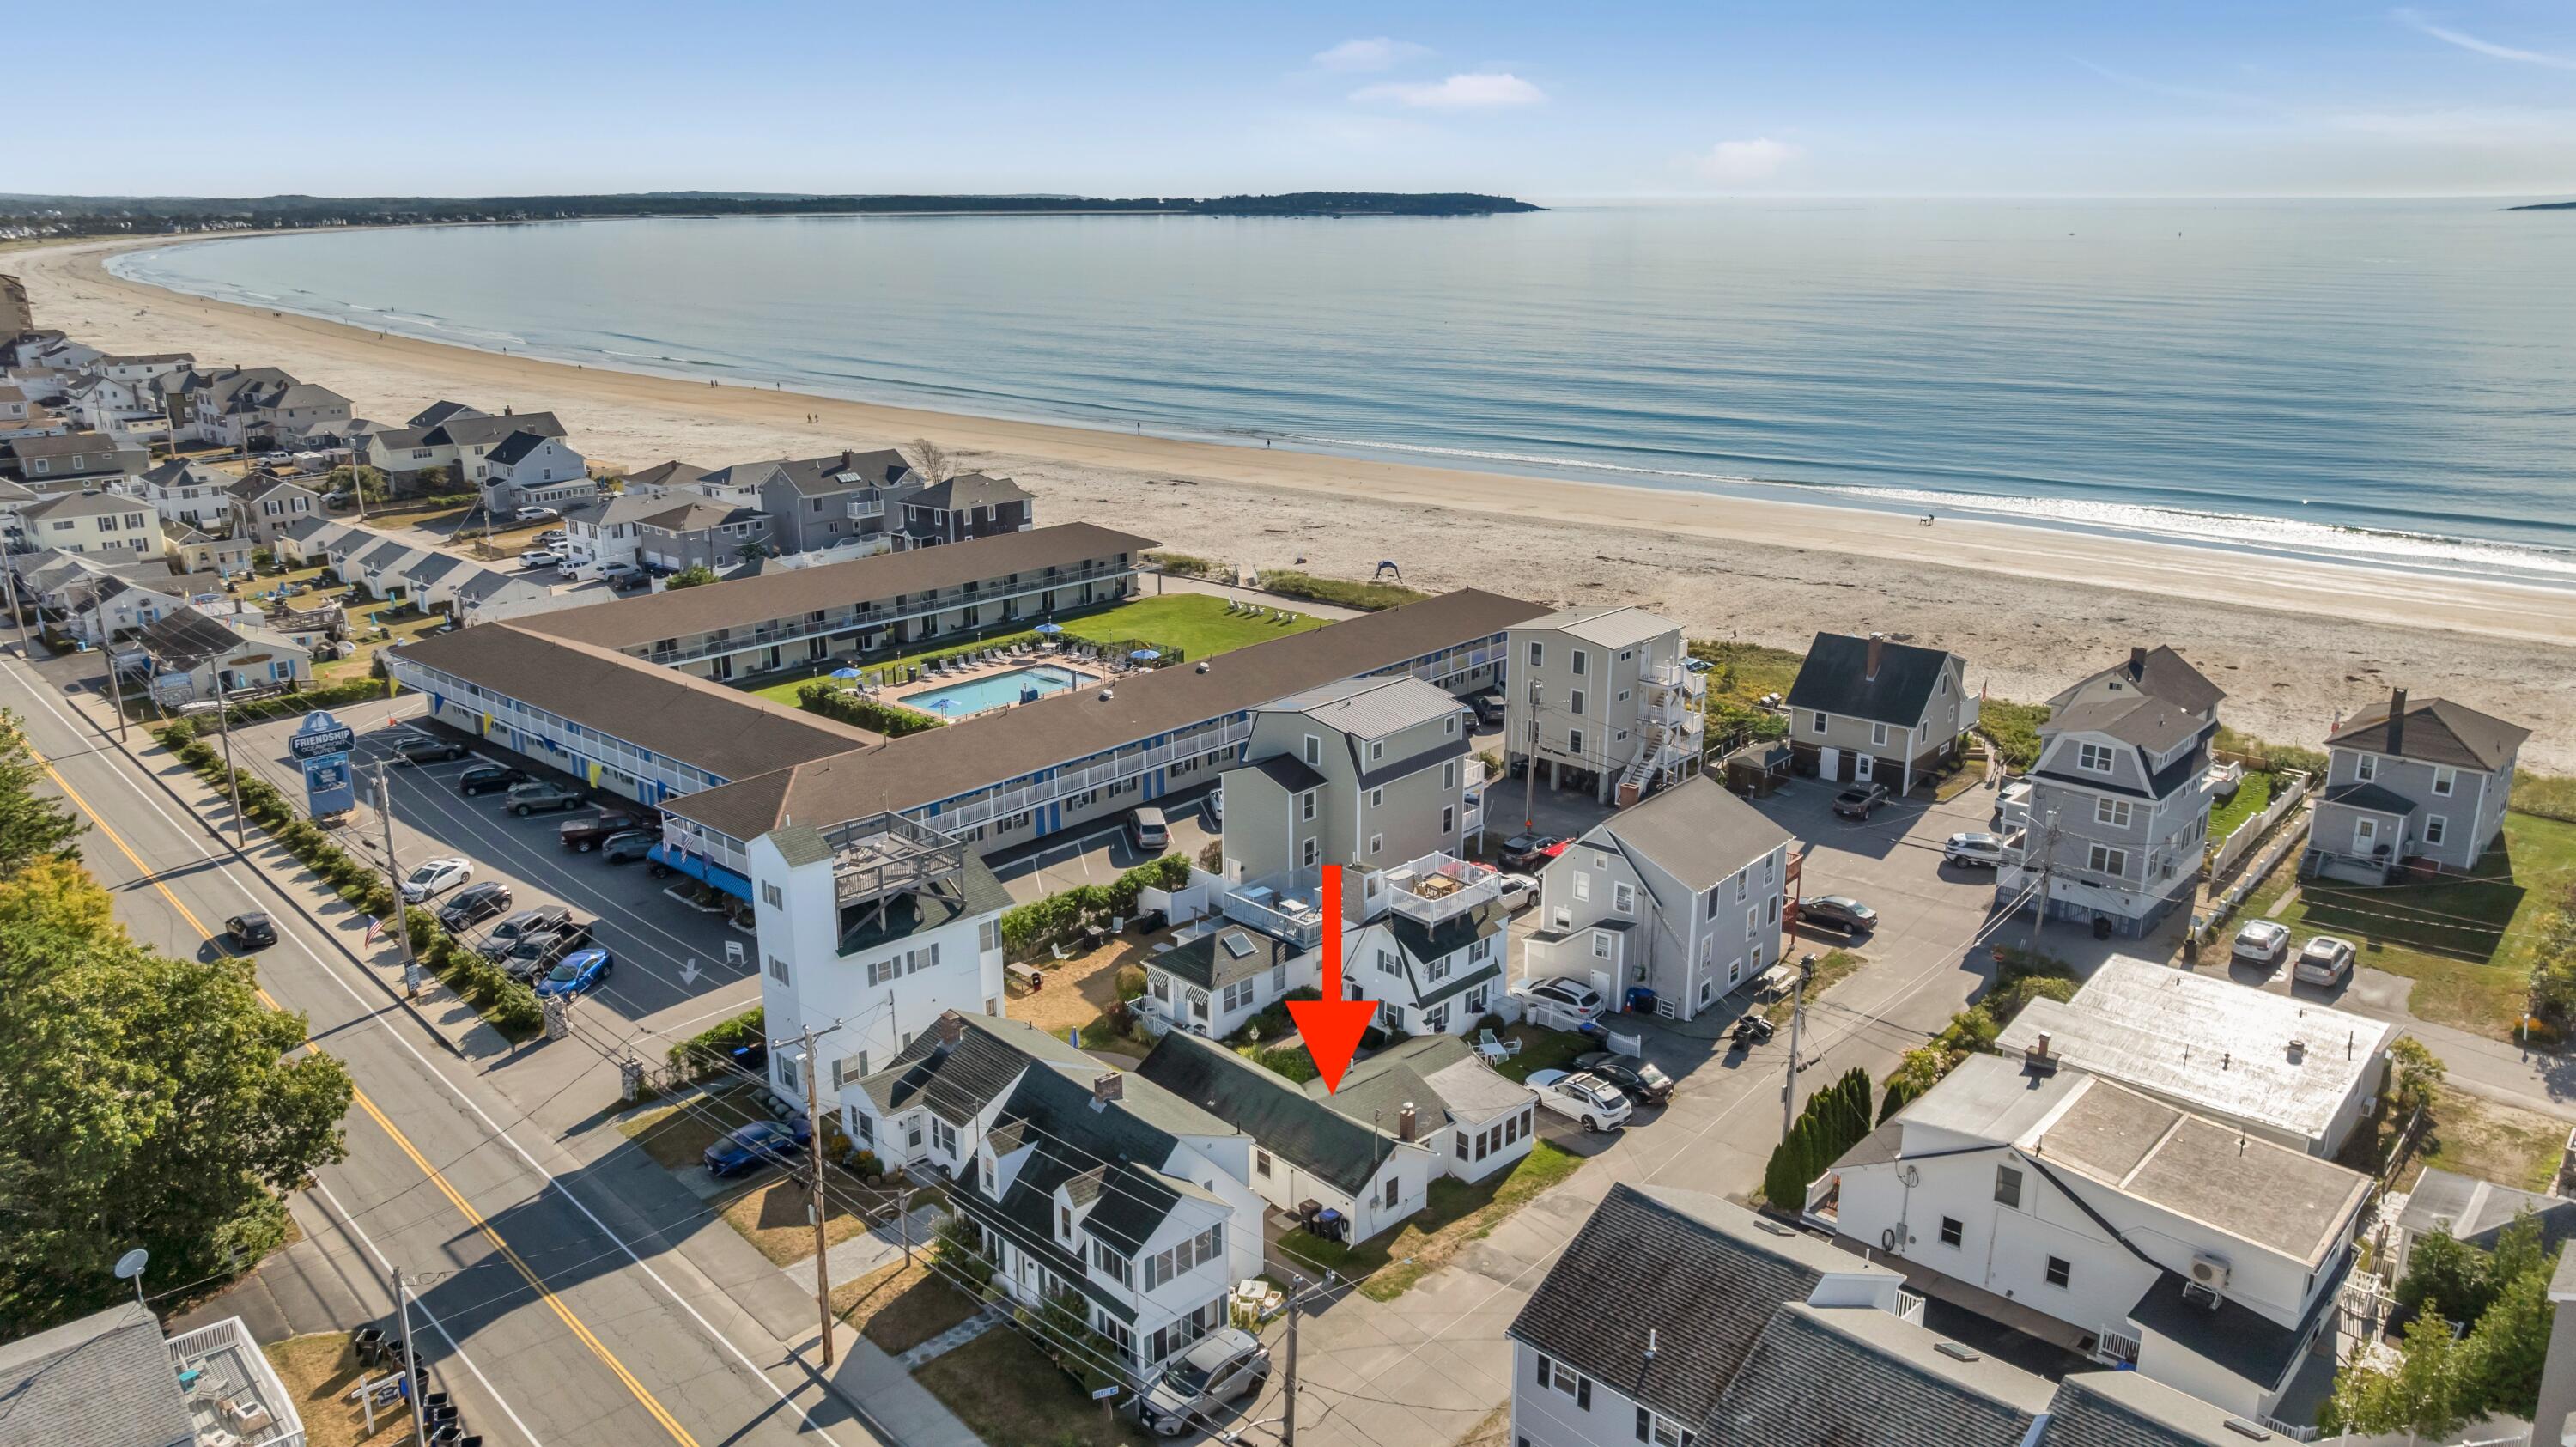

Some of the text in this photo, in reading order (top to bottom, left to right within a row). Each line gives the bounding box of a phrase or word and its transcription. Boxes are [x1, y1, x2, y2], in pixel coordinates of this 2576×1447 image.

[295, 730, 350, 748] FRIENDSHIP
[301, 739, 345, 752] OCEANFRONT
[313, 747, 336, 756] SUITES
